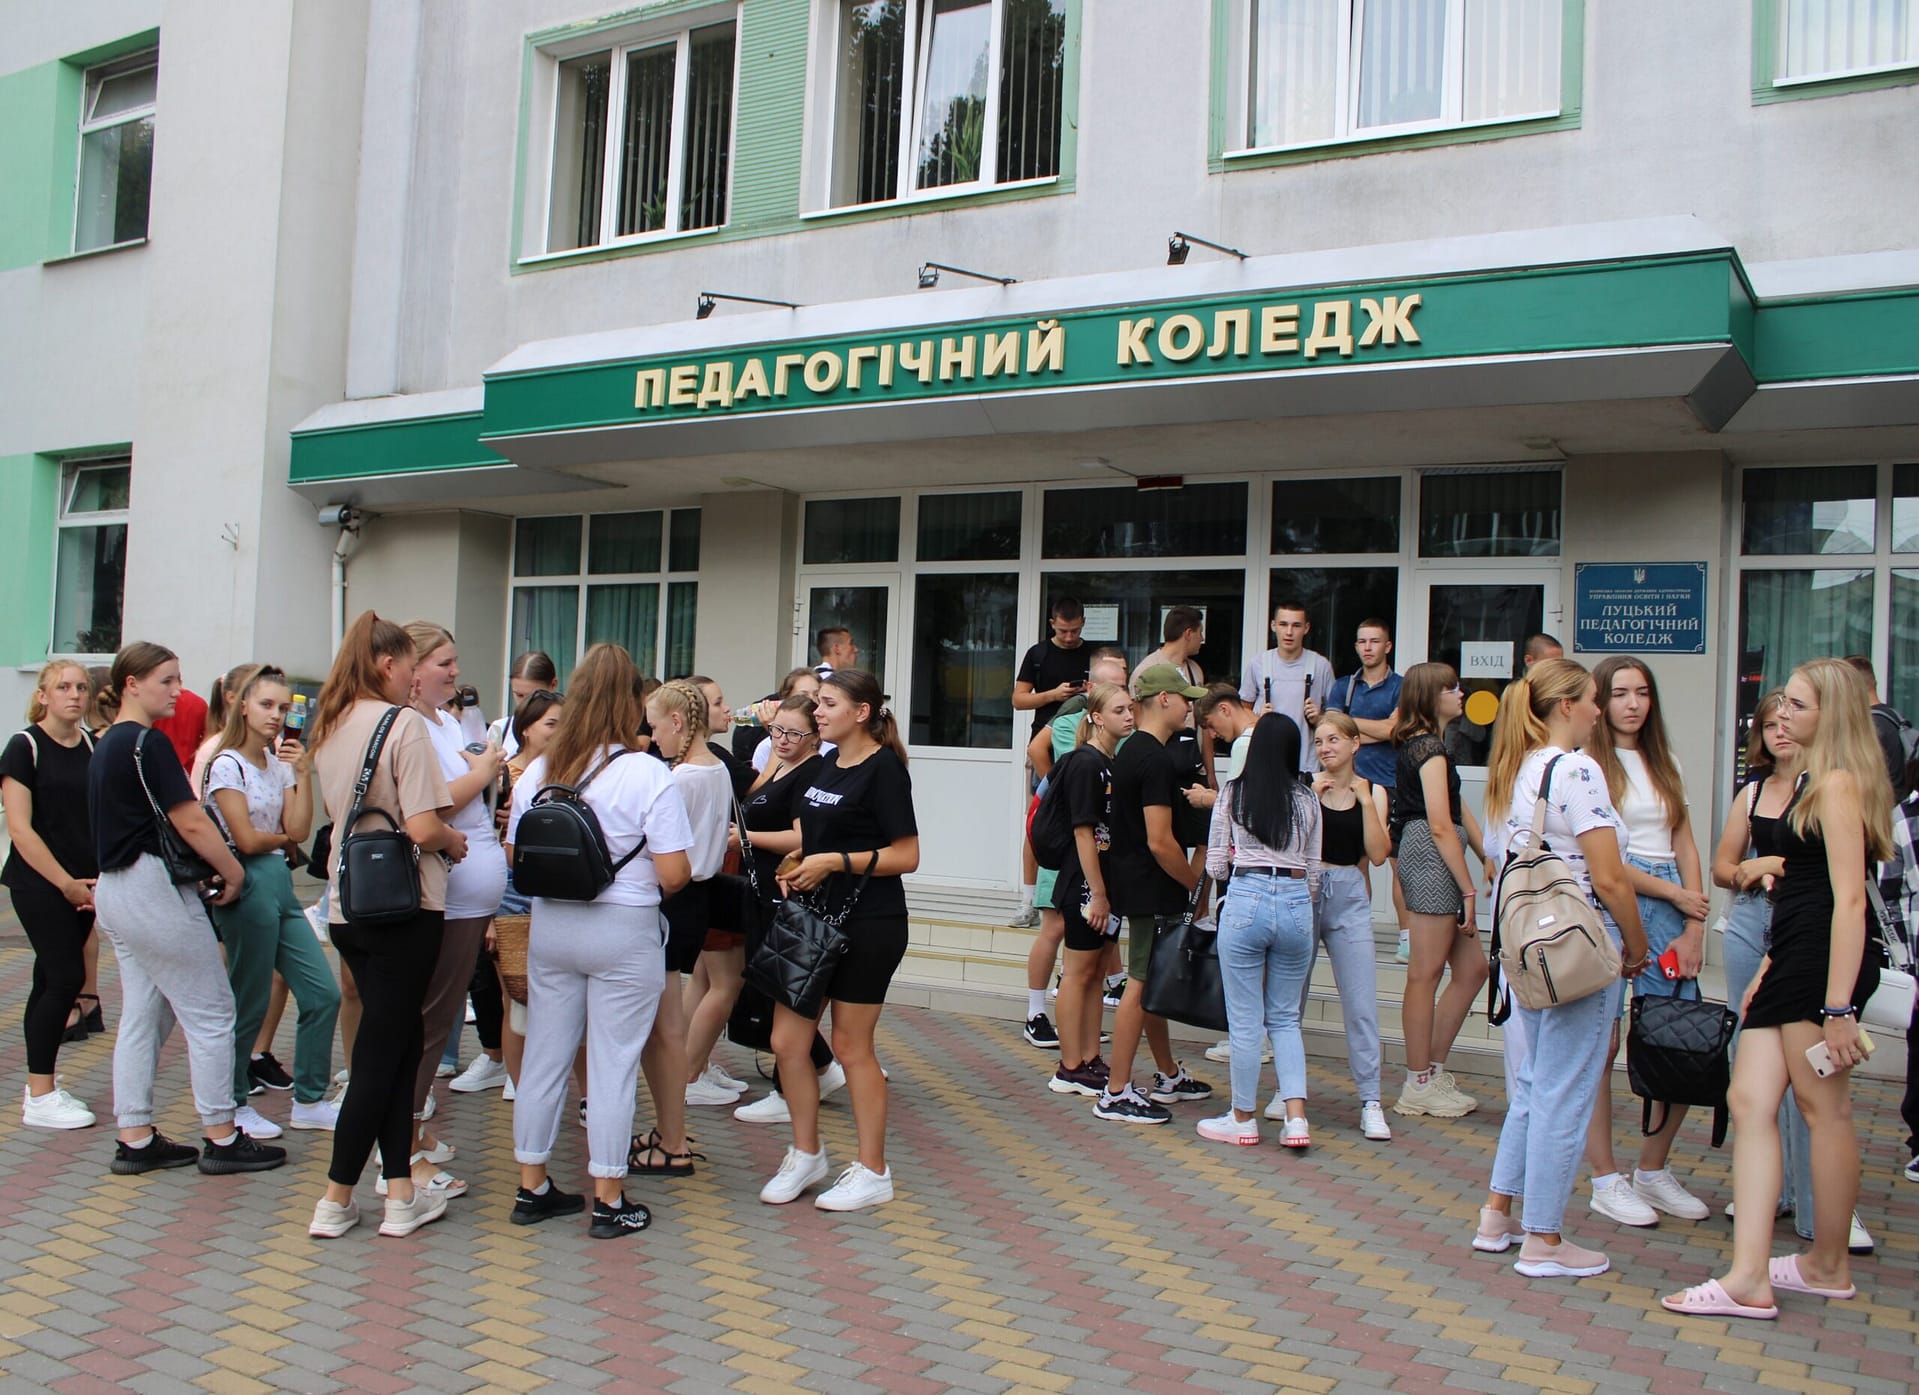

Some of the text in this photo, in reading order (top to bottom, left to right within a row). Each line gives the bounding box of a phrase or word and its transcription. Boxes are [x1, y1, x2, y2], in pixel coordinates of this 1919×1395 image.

[634, 293, 1422, 411] ПЕДАГОГІЧНИЙ КОЛЕДЖ
[1602, 603, 1678, 617] ЛУЦЬКИЙ
[1580, 617, 1699, 631] ПЕДАГОГІЧНИЙ
[1604, 633, 1673, 645] КОЛЕДЖ
[1470, 655, 1504, 668] ВХІД
